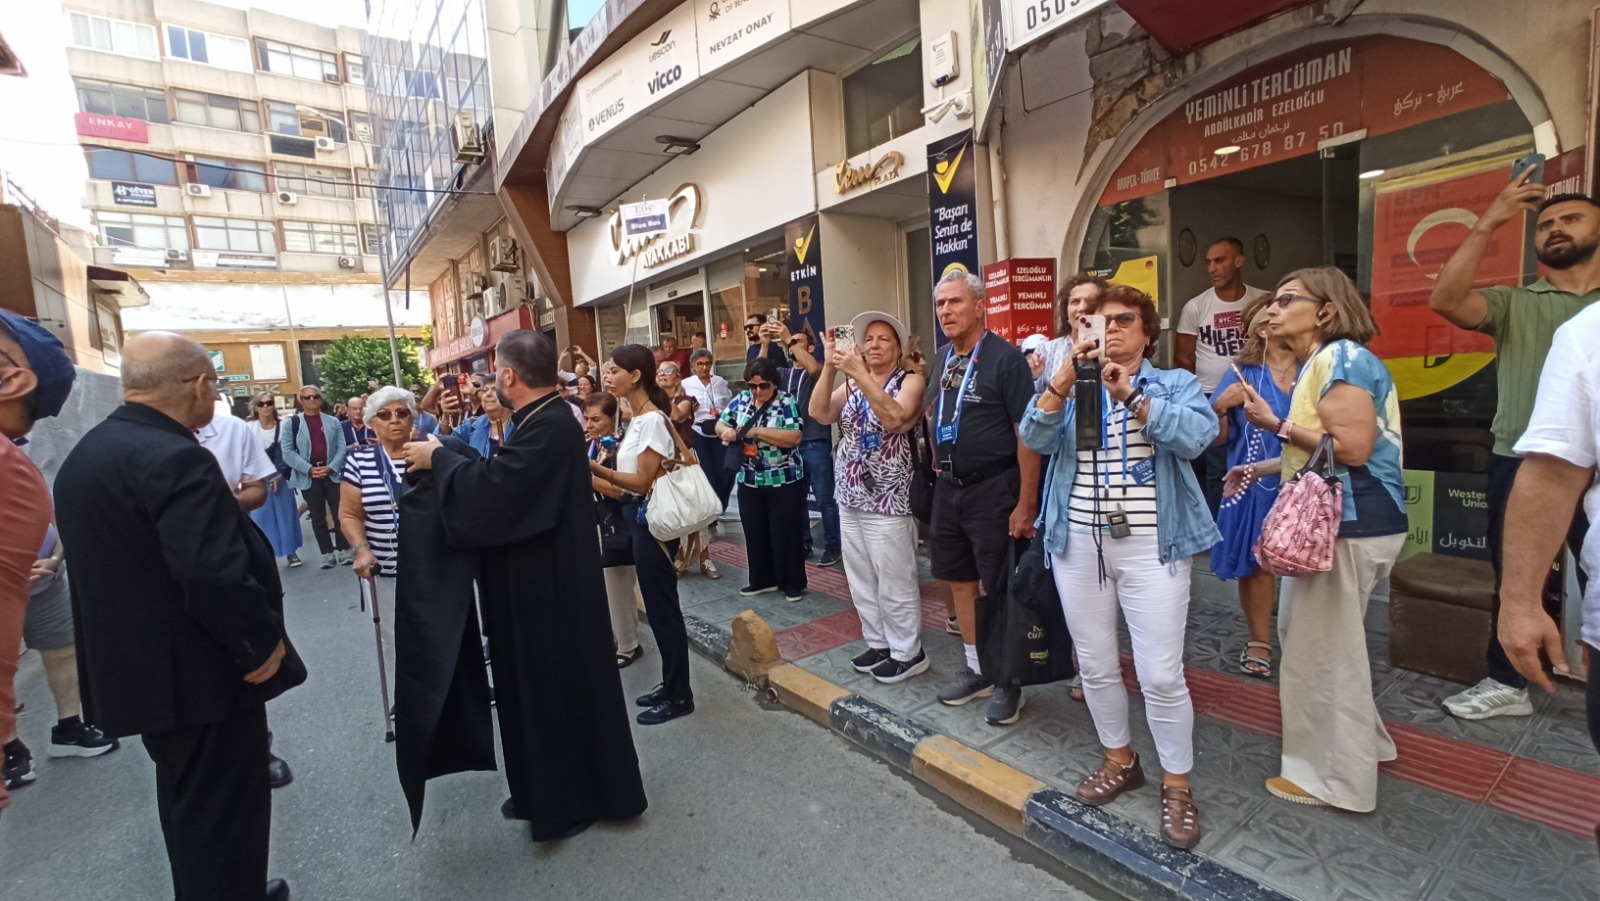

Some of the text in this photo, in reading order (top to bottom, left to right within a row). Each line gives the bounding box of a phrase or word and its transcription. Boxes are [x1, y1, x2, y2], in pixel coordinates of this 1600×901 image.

[709, 12, 774, 55] NEVZAT ONAY
[647, 64, 682, 96] vicco
[1251, 47, 1351, 103] TERCÜMAN
[1272, 89, 1324, 117] EZELOĞLU
[88, 117, 133, 129] ENKAY
[1189, 121, 1344, 175] 0542 678 87 50
[934, 219, 973, 239] Senin de
[643, 233, 692, 269] AYAKKABI
[1013, 301, 1052, 310] TERCÜMAN
[1462, 499, 1488, 508] Unio
